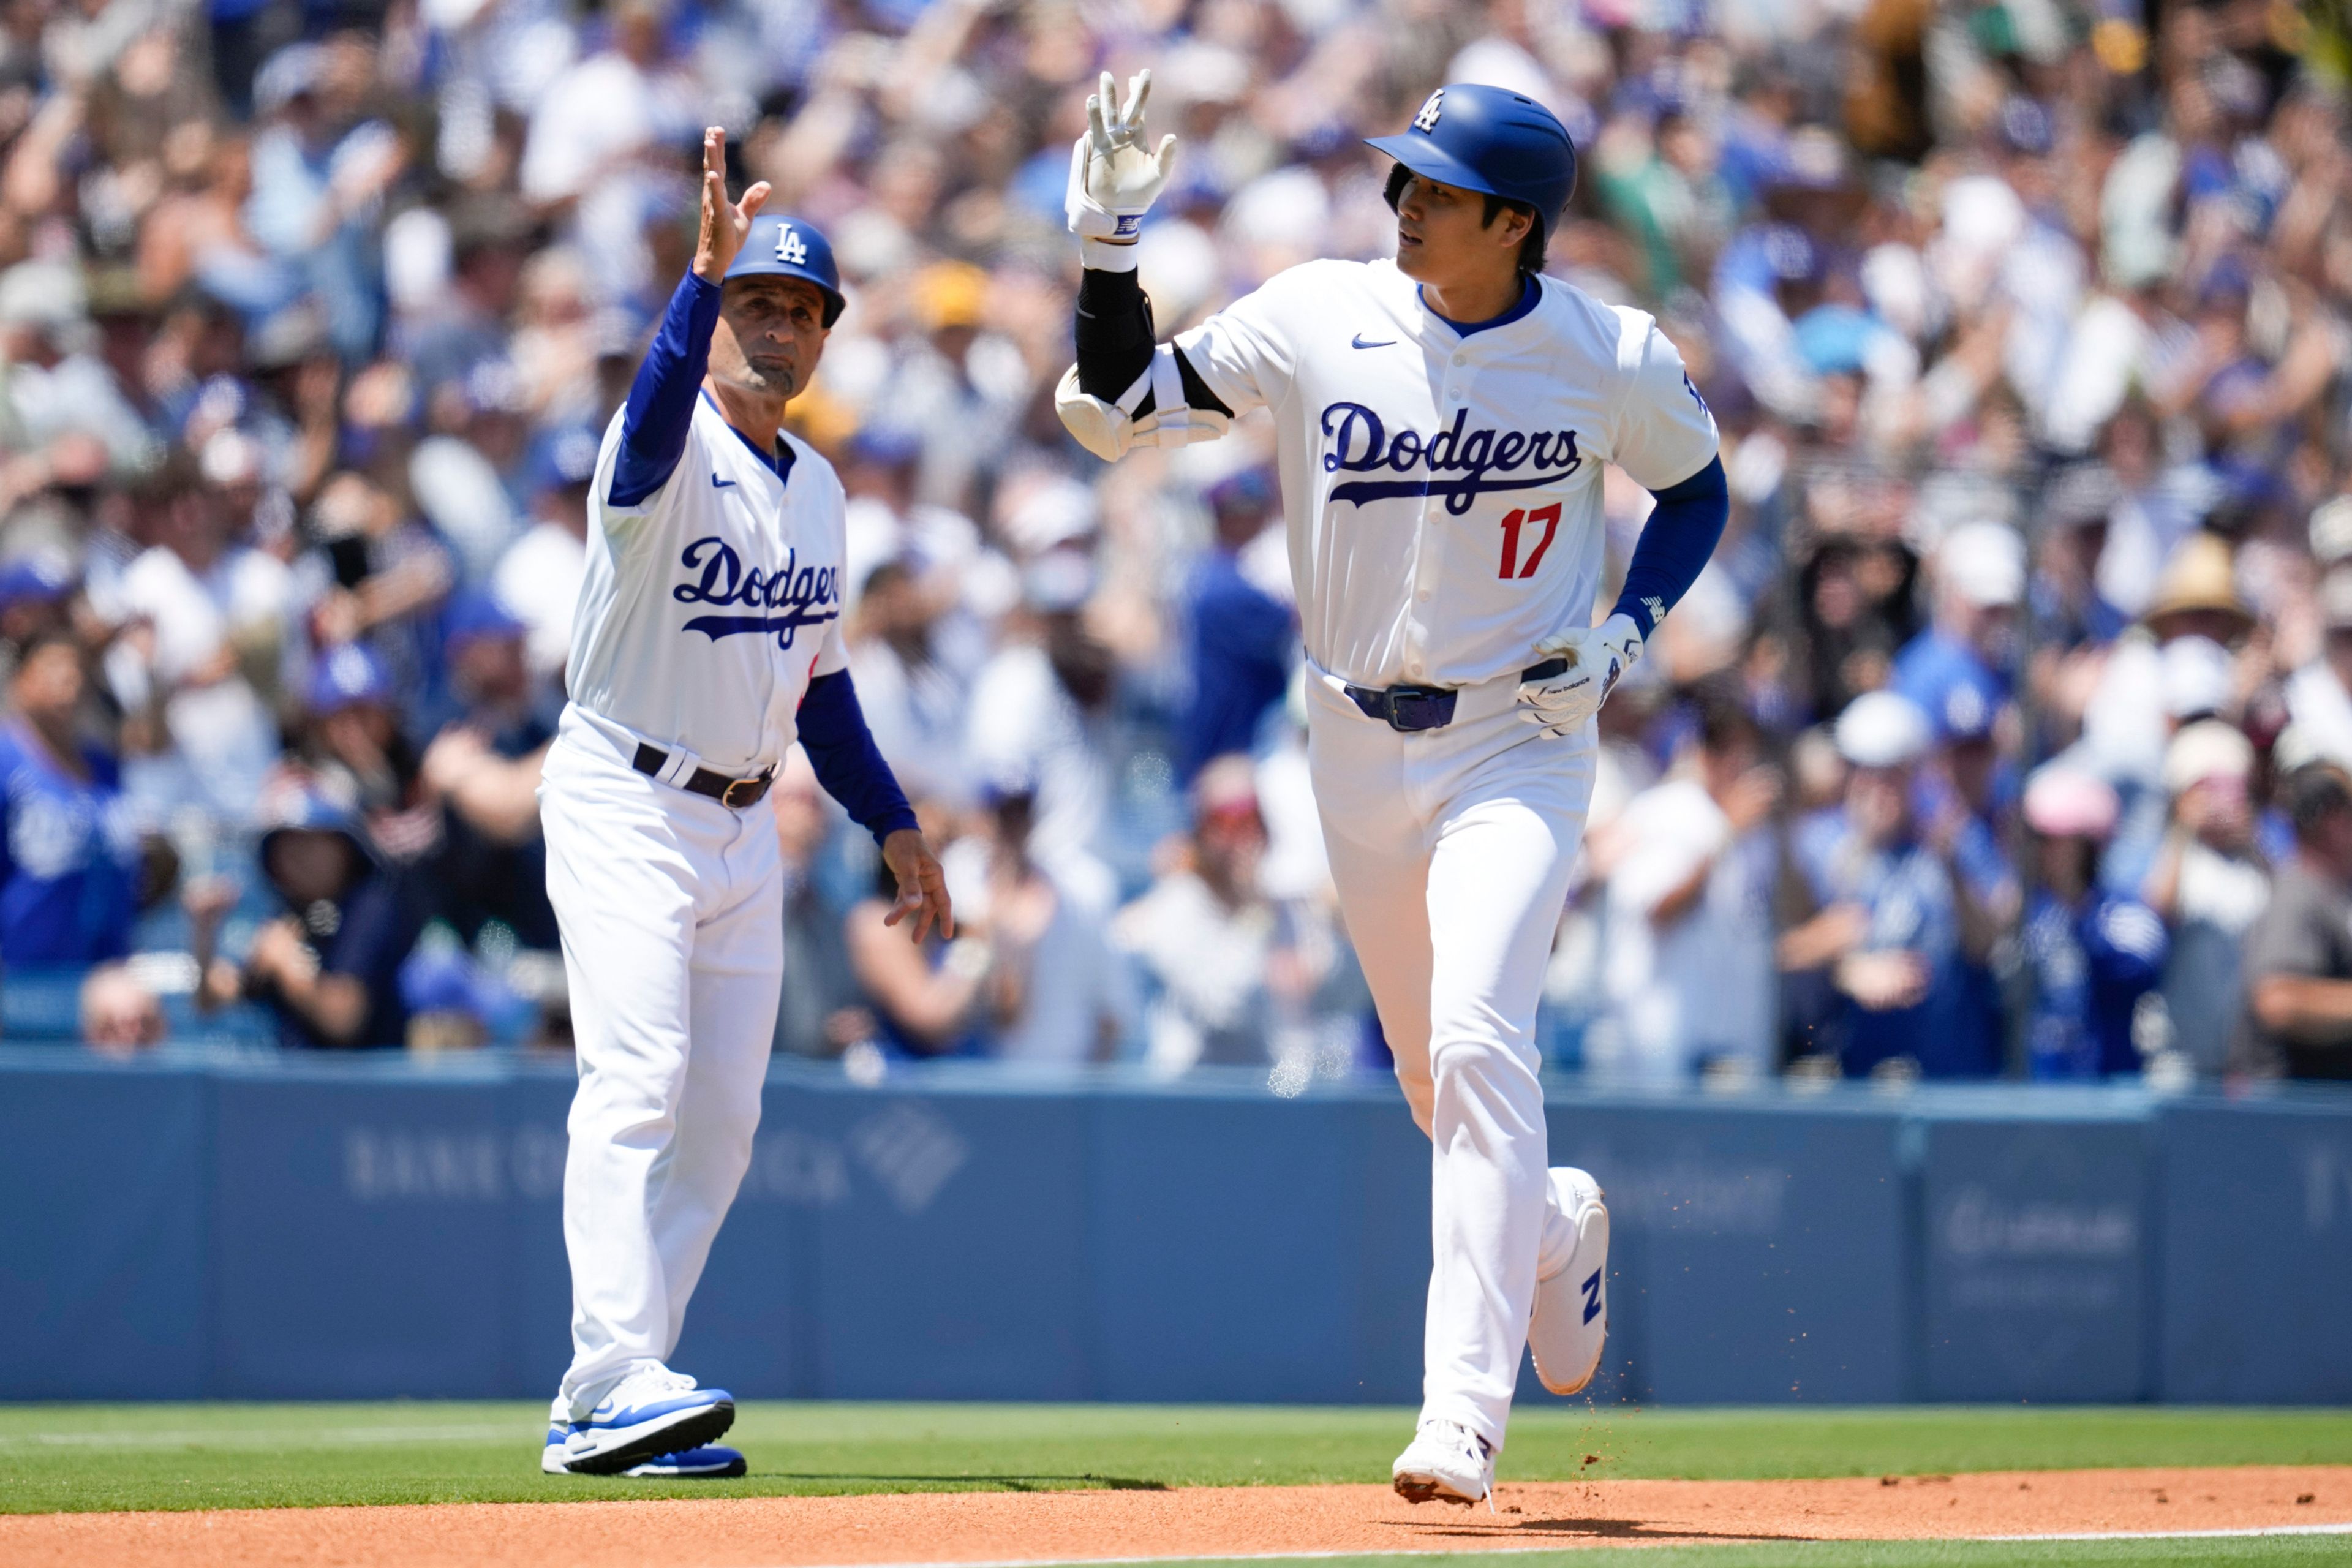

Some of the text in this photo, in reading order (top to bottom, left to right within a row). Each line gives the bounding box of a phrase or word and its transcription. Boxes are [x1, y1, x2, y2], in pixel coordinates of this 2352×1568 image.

[1414, 89, 1445, 132] LA
[774, 223, 808, 265] LA
[1321, 401, 1582, 516] Dodgers
[1498, 502, 1562, 579] 17
[673, 535, 840, 650] Dodger
[1563, 676, 1591, 692] balance
